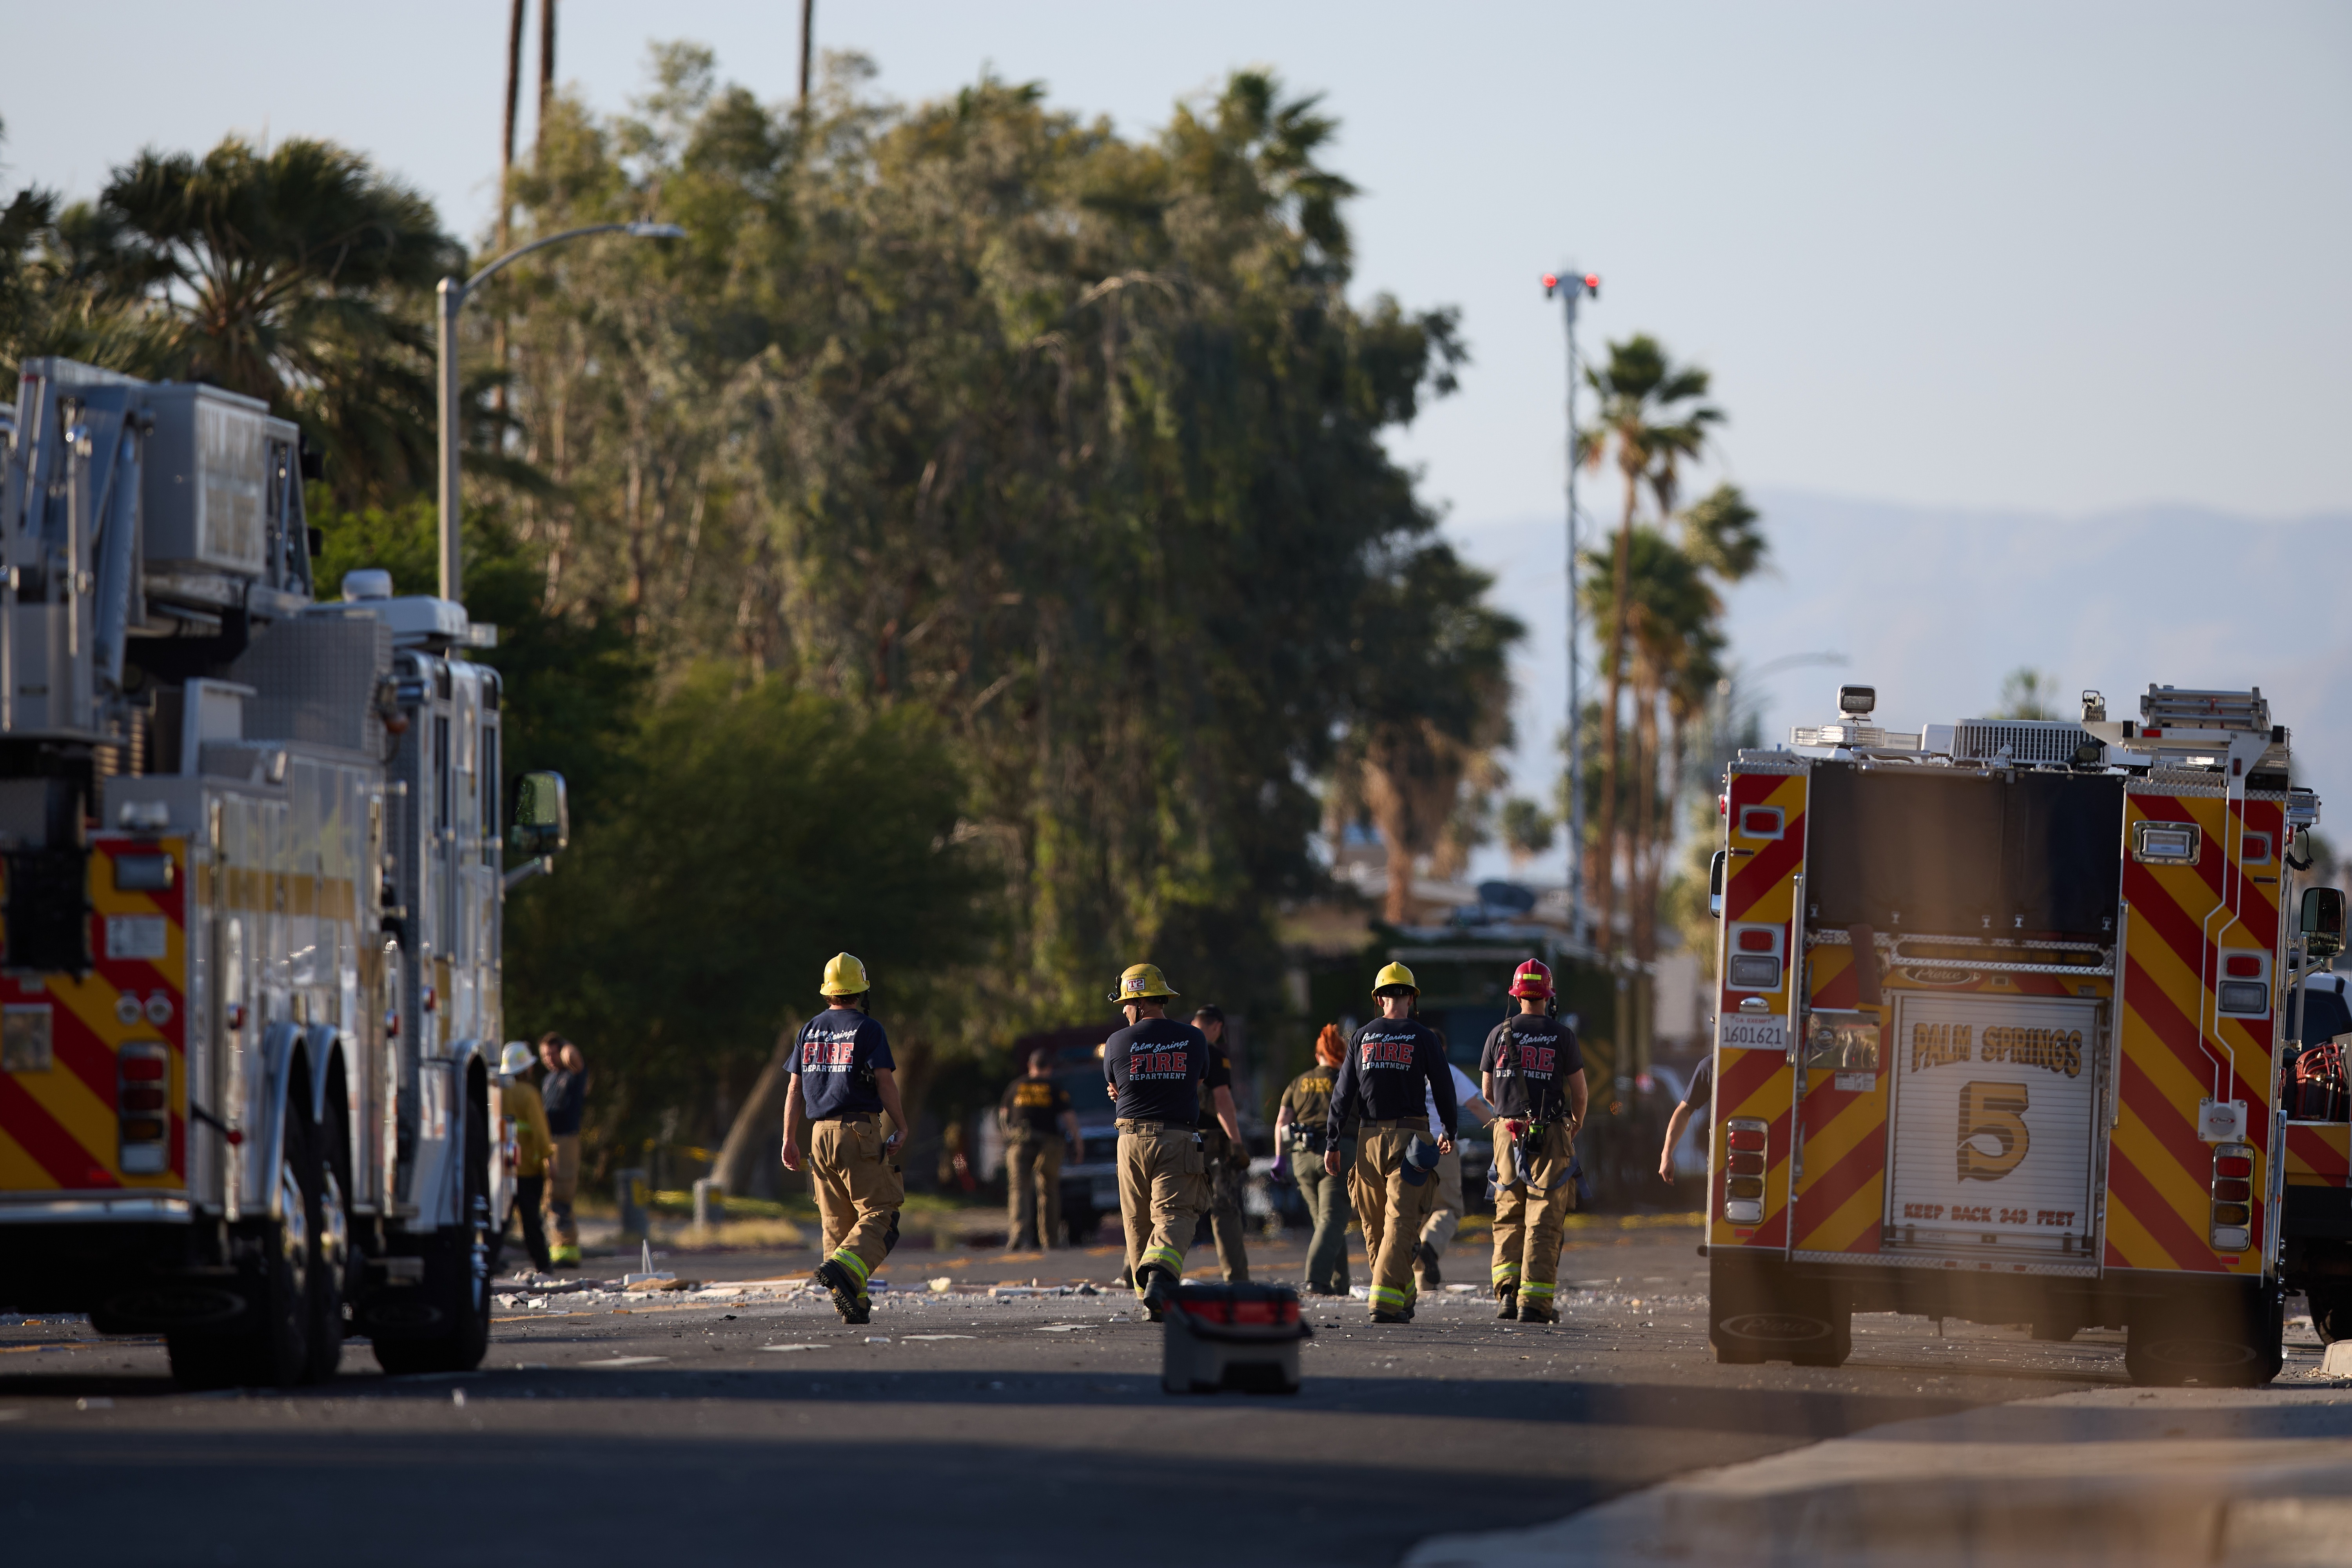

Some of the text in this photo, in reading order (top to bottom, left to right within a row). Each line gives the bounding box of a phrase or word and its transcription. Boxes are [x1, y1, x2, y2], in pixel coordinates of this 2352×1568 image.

[1915, 968, 1961, 979] Pierce
[1129, 979, 1143, 987] T2
[804, 1029, 857, 1042] Palm Springs
[1361, 1032, 1416, 1043] Palm Springs
[1519, 1033, 1557, 1044] Springs
[1724, 1026, 1782, 1044] 1601621
[802, 1042, 854, 1064] FIRE
[1130, 1040, 1189, 1053] Palm Springs
[1361, 1042, 1414, 1064] FIRE
[1911, 1022, 2082, 1078] PALM SPRINGS
[1130, 1052, 1187, 1073] FIRE
[1362, 1062, 1410, 1071] DEPARTMENT
[1496, 1045, 1555, 1072] FRE
[1956, 1081, 2030, 1185] 5
[1904, 1203, 2075, 1227] KEEP BACK 343 FEET
